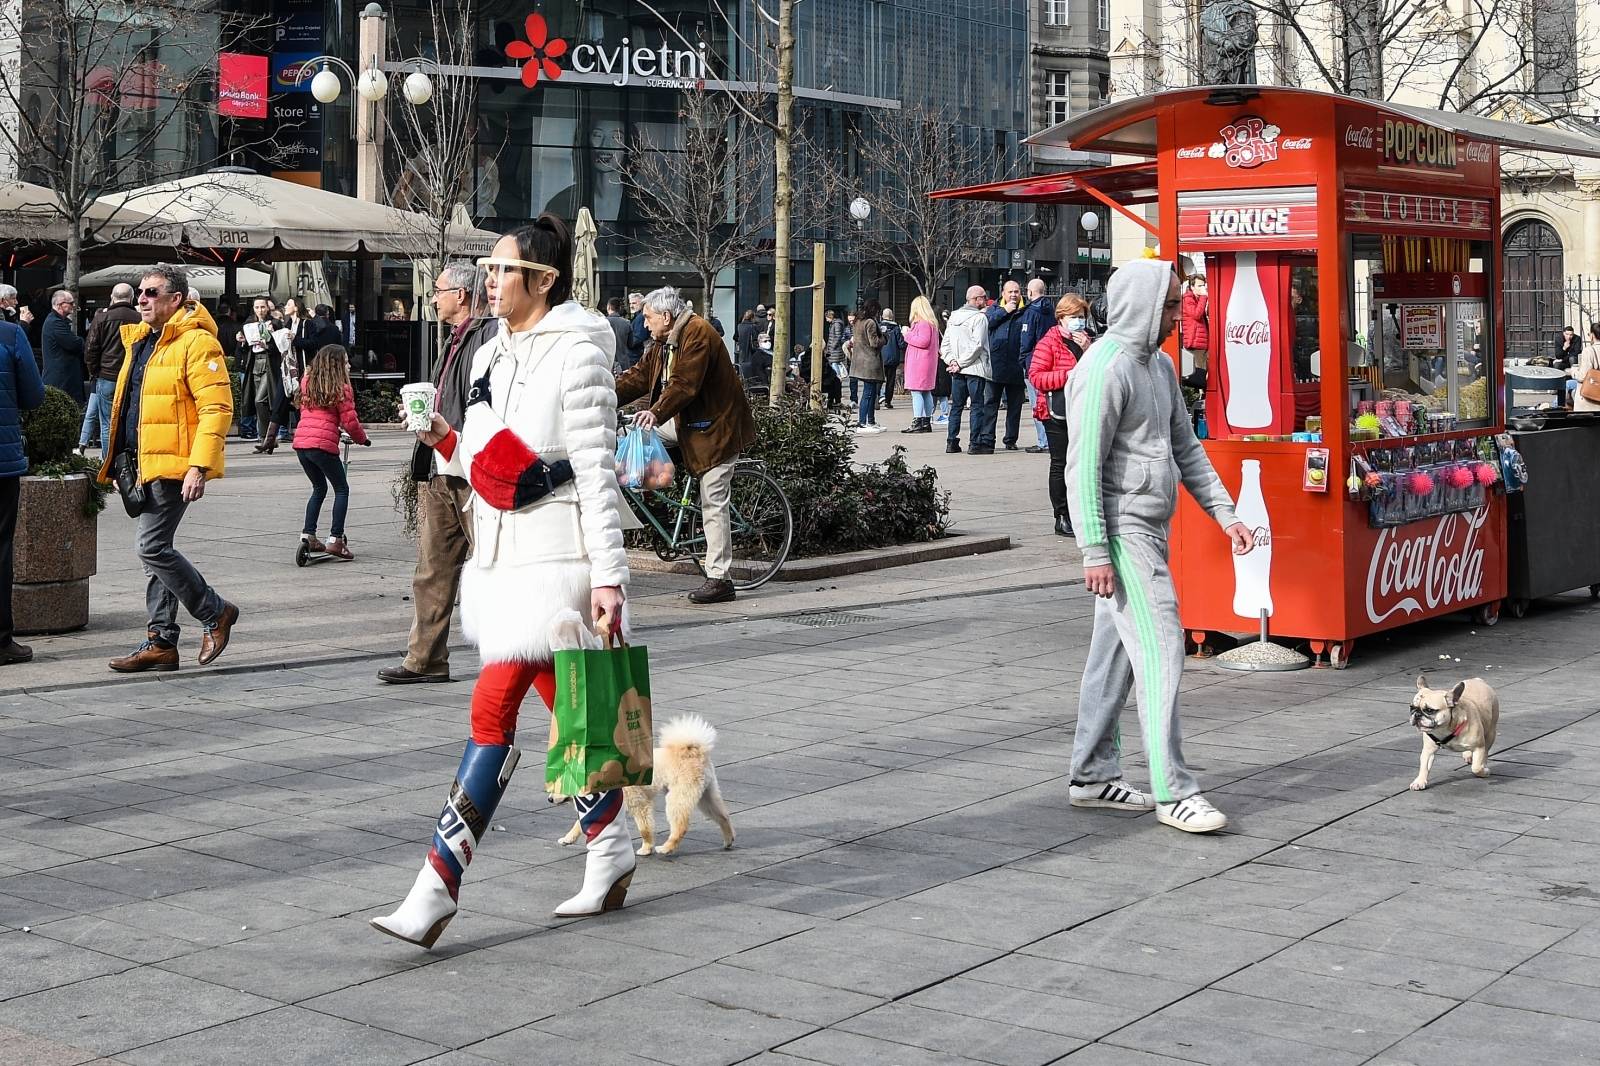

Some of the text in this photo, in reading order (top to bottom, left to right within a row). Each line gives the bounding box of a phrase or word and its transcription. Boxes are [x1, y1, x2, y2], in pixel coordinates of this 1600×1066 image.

[282, 69, 312, 77] PEPO
[571, 37, 706, 87] cvjetni
[240, 91, 259, 100] Bank
[274, 106, 304, 117] Store
[1220, 118, 1264, 148] POP
[1282, 138, 1312, 150] Coca-Cola
[1345, 124, 1374, 149] Coca-Cola
[1385, 119, 1457, 166] POPCORN
[1177, 147, 1206, 159] Coca-Cola
[1225, 138, 1278, 168] CORN
[1466, 141, 1491, 163] Coca-Cola
[1207, 207, 1290, 236] KOKICE
[1382, 194, 1459, 224] KOKICE
[218, 229, 250, 246] jana
[1226, 320, 1269, 345] Coca-Cola
[1366, 502, 1490, 624] Coca-Cola
